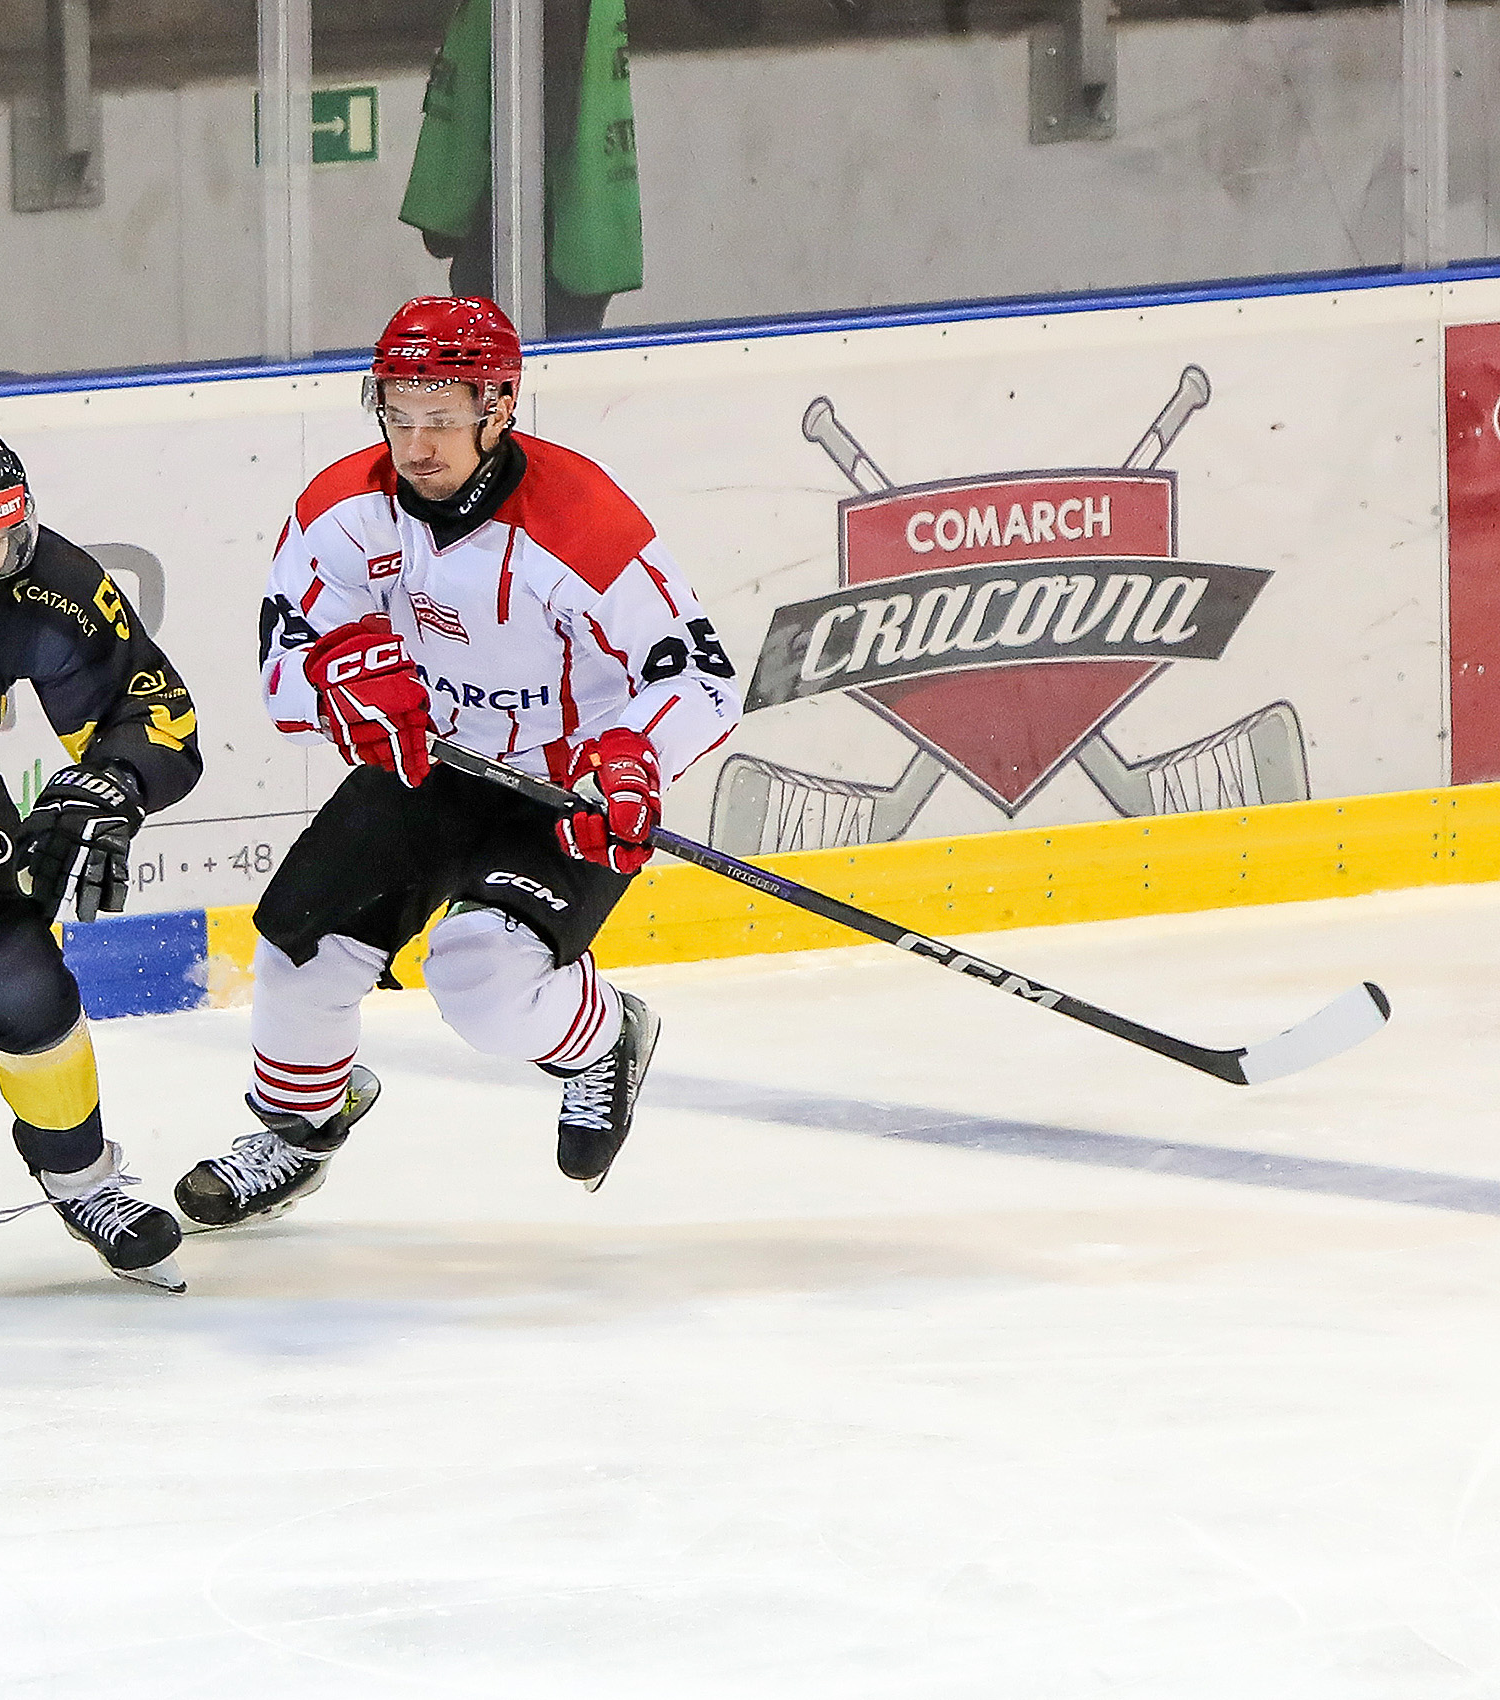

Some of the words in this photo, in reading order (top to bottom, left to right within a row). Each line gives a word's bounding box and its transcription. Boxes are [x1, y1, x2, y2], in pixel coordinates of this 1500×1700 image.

[388, 347, 430, 358] CCM
[905, 495, 1112, 553] COMARCH
[371, 558, 402, 575] CC
[26, 586, 98, 638] CATAPULT
[228, 843, 273, 880] 48
[484, 870, 570, 912] CCM
[896, 932, 1064, 1009] CCM
